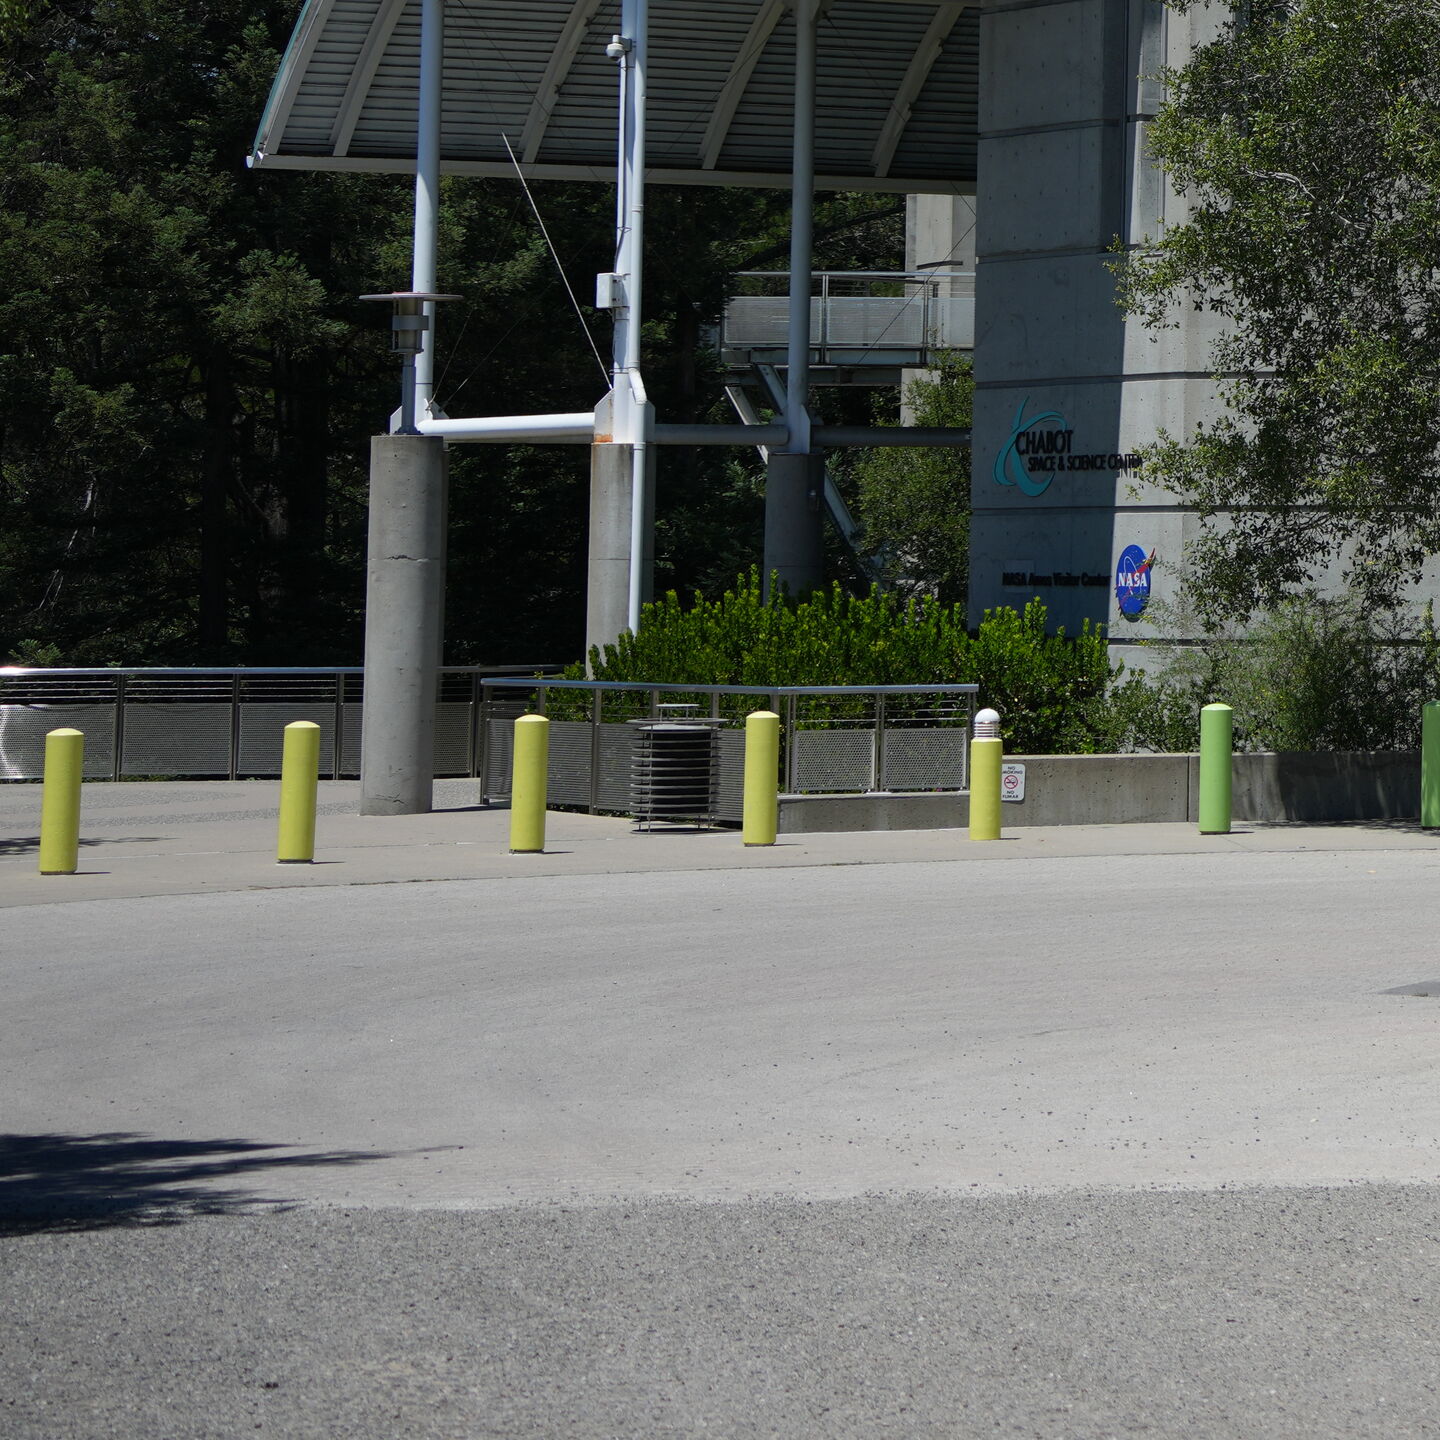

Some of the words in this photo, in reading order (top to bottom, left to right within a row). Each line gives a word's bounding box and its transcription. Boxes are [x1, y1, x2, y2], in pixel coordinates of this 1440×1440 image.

[1015, 430, 1073, 454] CHABOT
[1028, 456, 1056, 472] SPACE
[1058, 455, 1065, 471] &
[1067, 455, 1106, 470] SCIENCE
[1118, 572, 1148, 587] NASA
